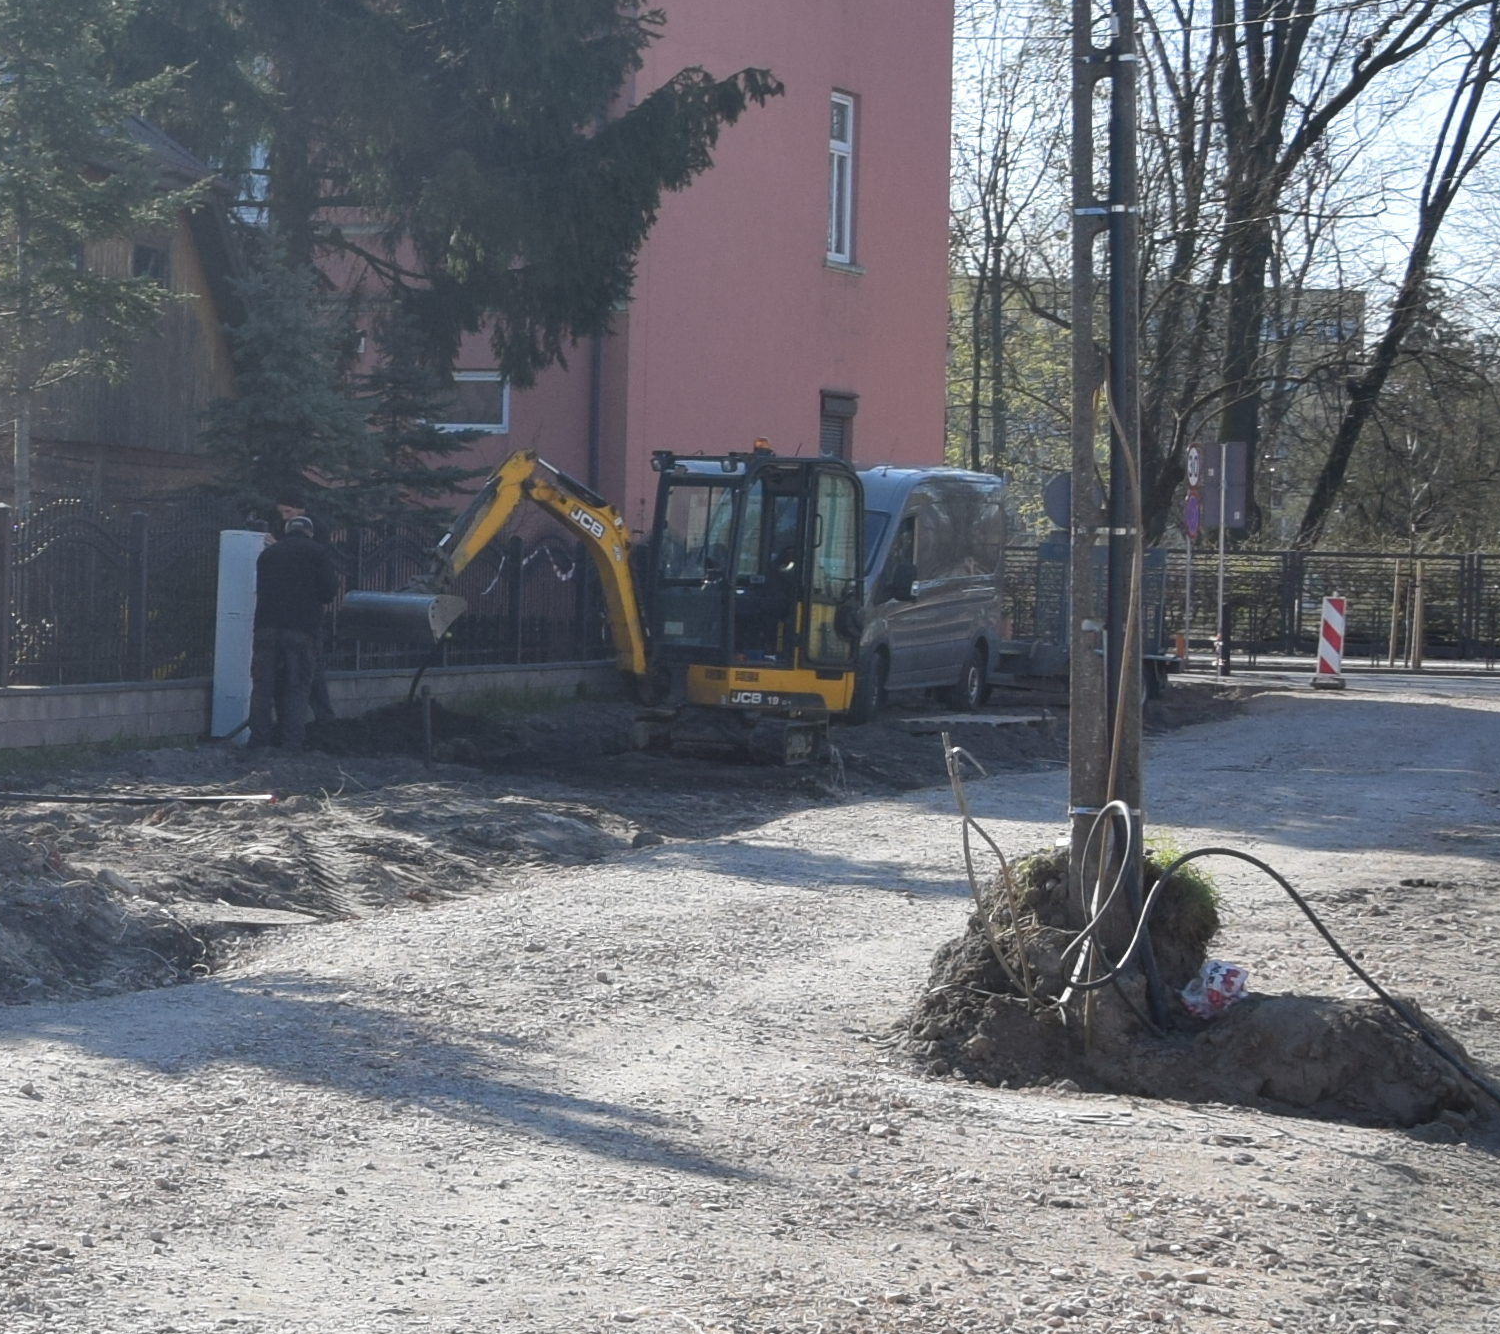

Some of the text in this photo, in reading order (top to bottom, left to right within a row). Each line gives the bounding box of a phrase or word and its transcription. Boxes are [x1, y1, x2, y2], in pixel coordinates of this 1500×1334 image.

[1189, 454, 1198, 478] 30
[570, 509, 604, 539] JCB
[731, 692, 762, 704] JCB
